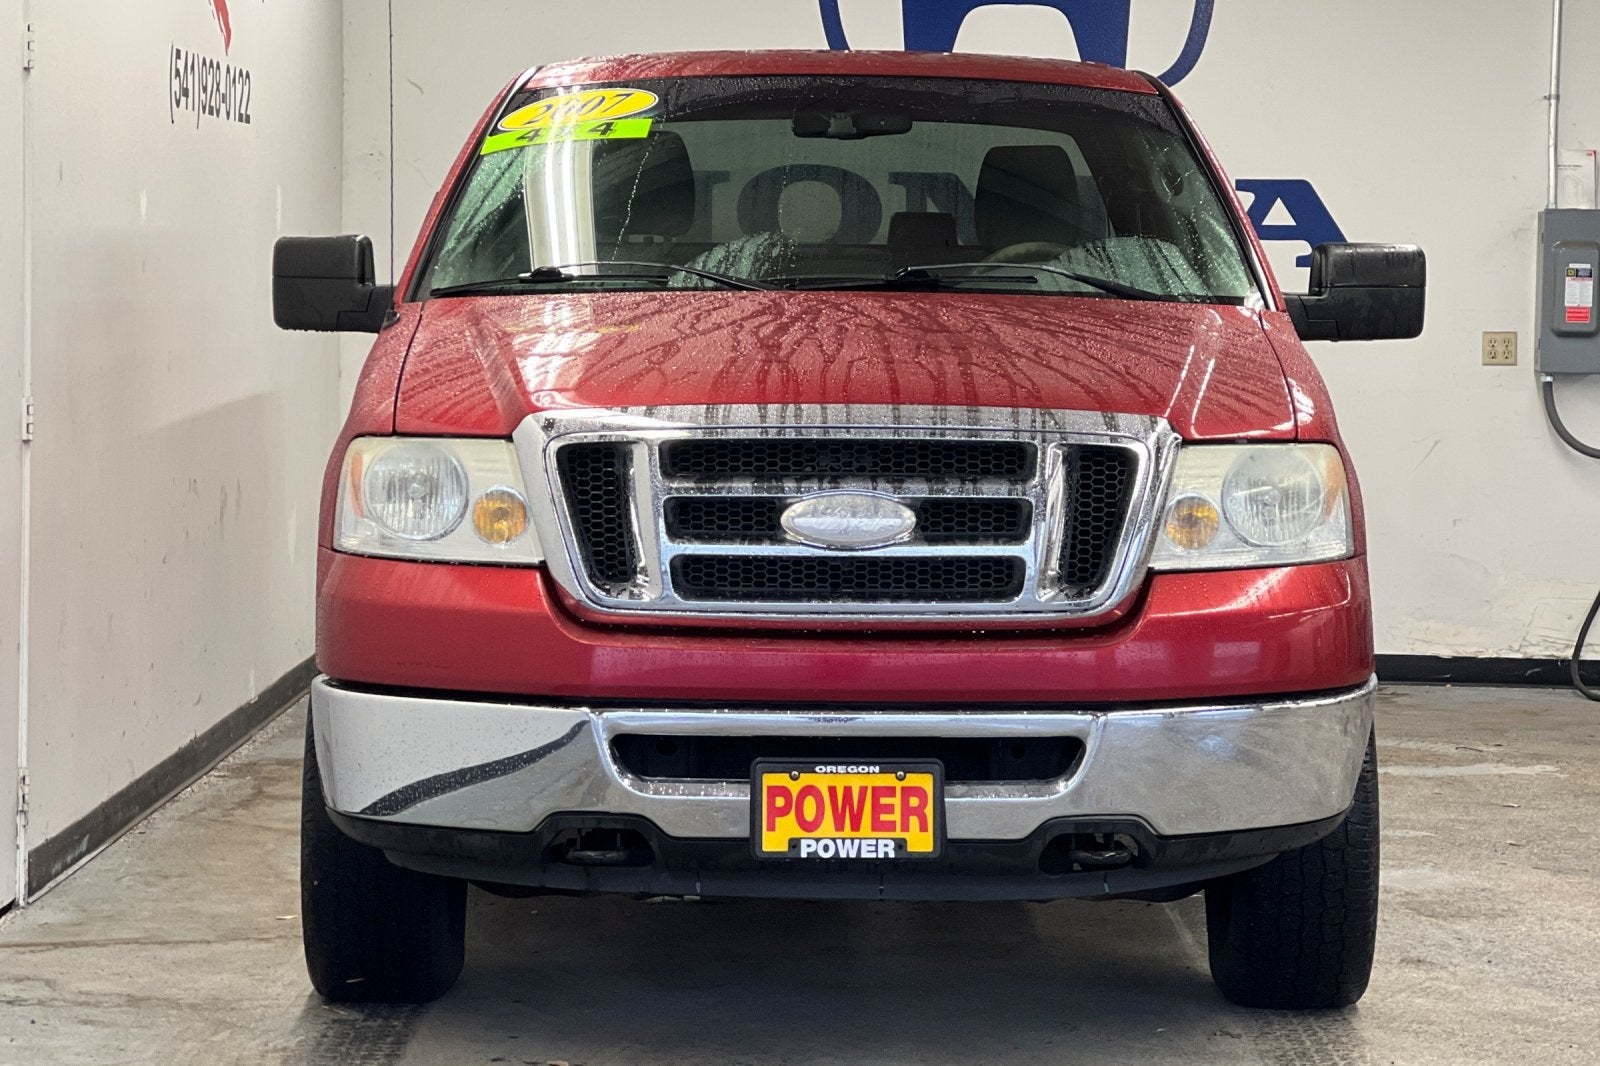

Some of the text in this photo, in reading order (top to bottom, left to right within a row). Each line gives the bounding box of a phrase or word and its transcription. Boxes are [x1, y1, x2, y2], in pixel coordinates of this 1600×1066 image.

[169, 40, 251, 129] (541)928-0122
[520, 92, 635, 127] 2007
[815, 765, 880, 773] OREGON
[766, 784, 929, 833] POWER
[800, 838, 896, 859] POWER
